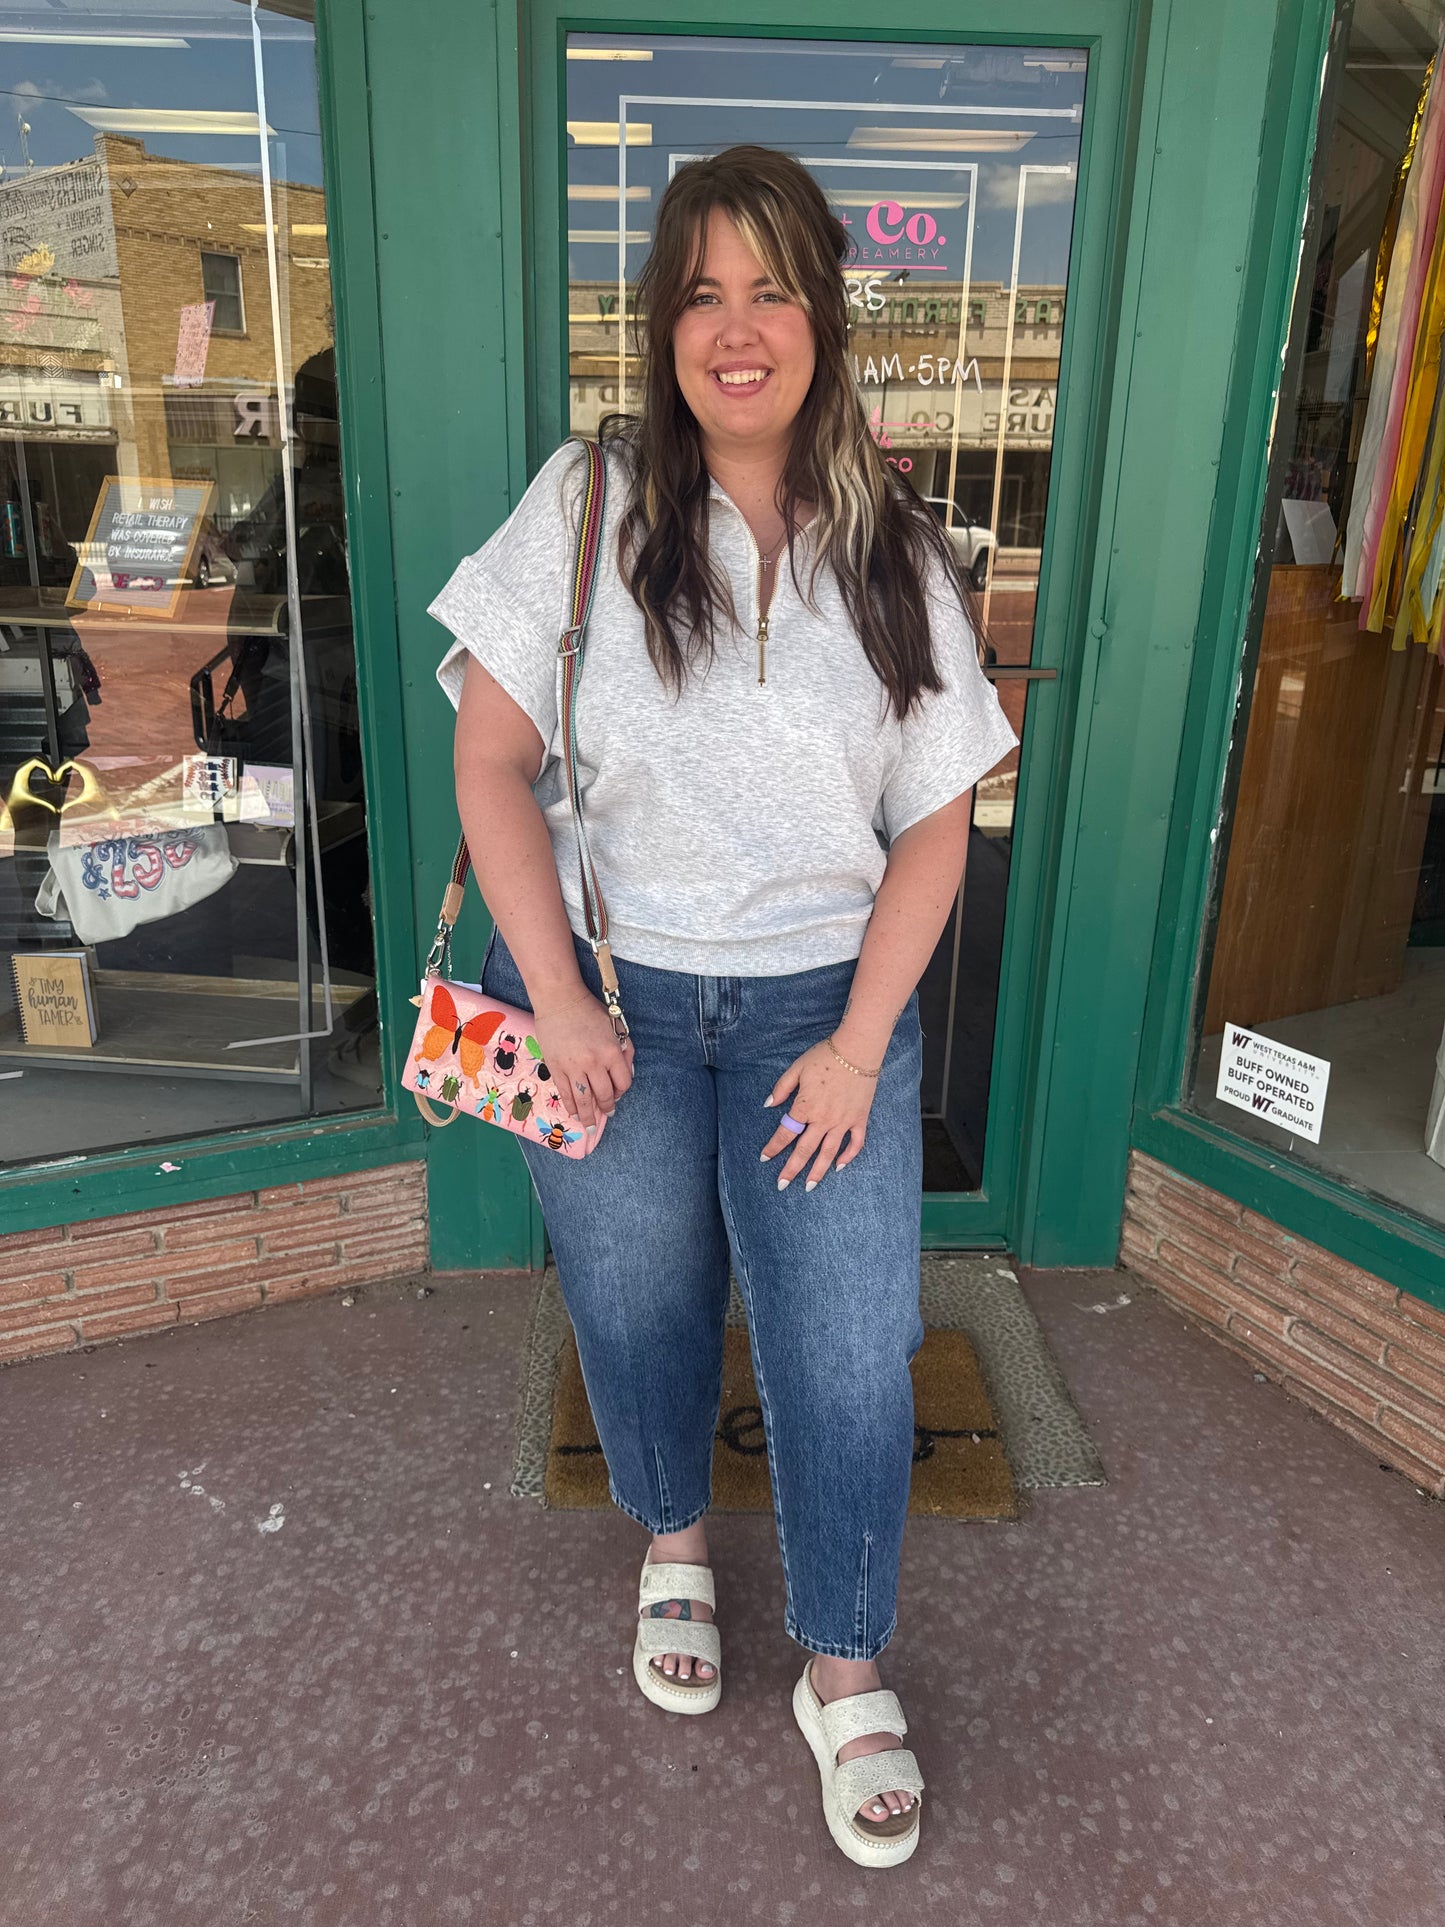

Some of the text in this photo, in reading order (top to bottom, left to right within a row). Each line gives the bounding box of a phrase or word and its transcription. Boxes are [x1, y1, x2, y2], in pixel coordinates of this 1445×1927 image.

[866, 200, 947, 246] Co.
[848, 247, 939, 260] REAMERY
[148, 497, 174, 511] WISH
[111, 512, 189, 530] RETAIL THERAPY
[111, 529, 131, 541] WAS
[107, 545, 176, 562] BY INSURANCE
[28, 988, 78, 1011] human
[38, 1009, 75, 1026] TAMER
[1231, 1031, 1316, 1073] WT WEST TEXAS A&M
[1236, 1055, 1309, 1094] BUFF OWNED
[1227, 1067, 1315, 1112] BUFF OPERATED
[1223, 1085, 1314, 1131] PROUD WT GRADUATE
